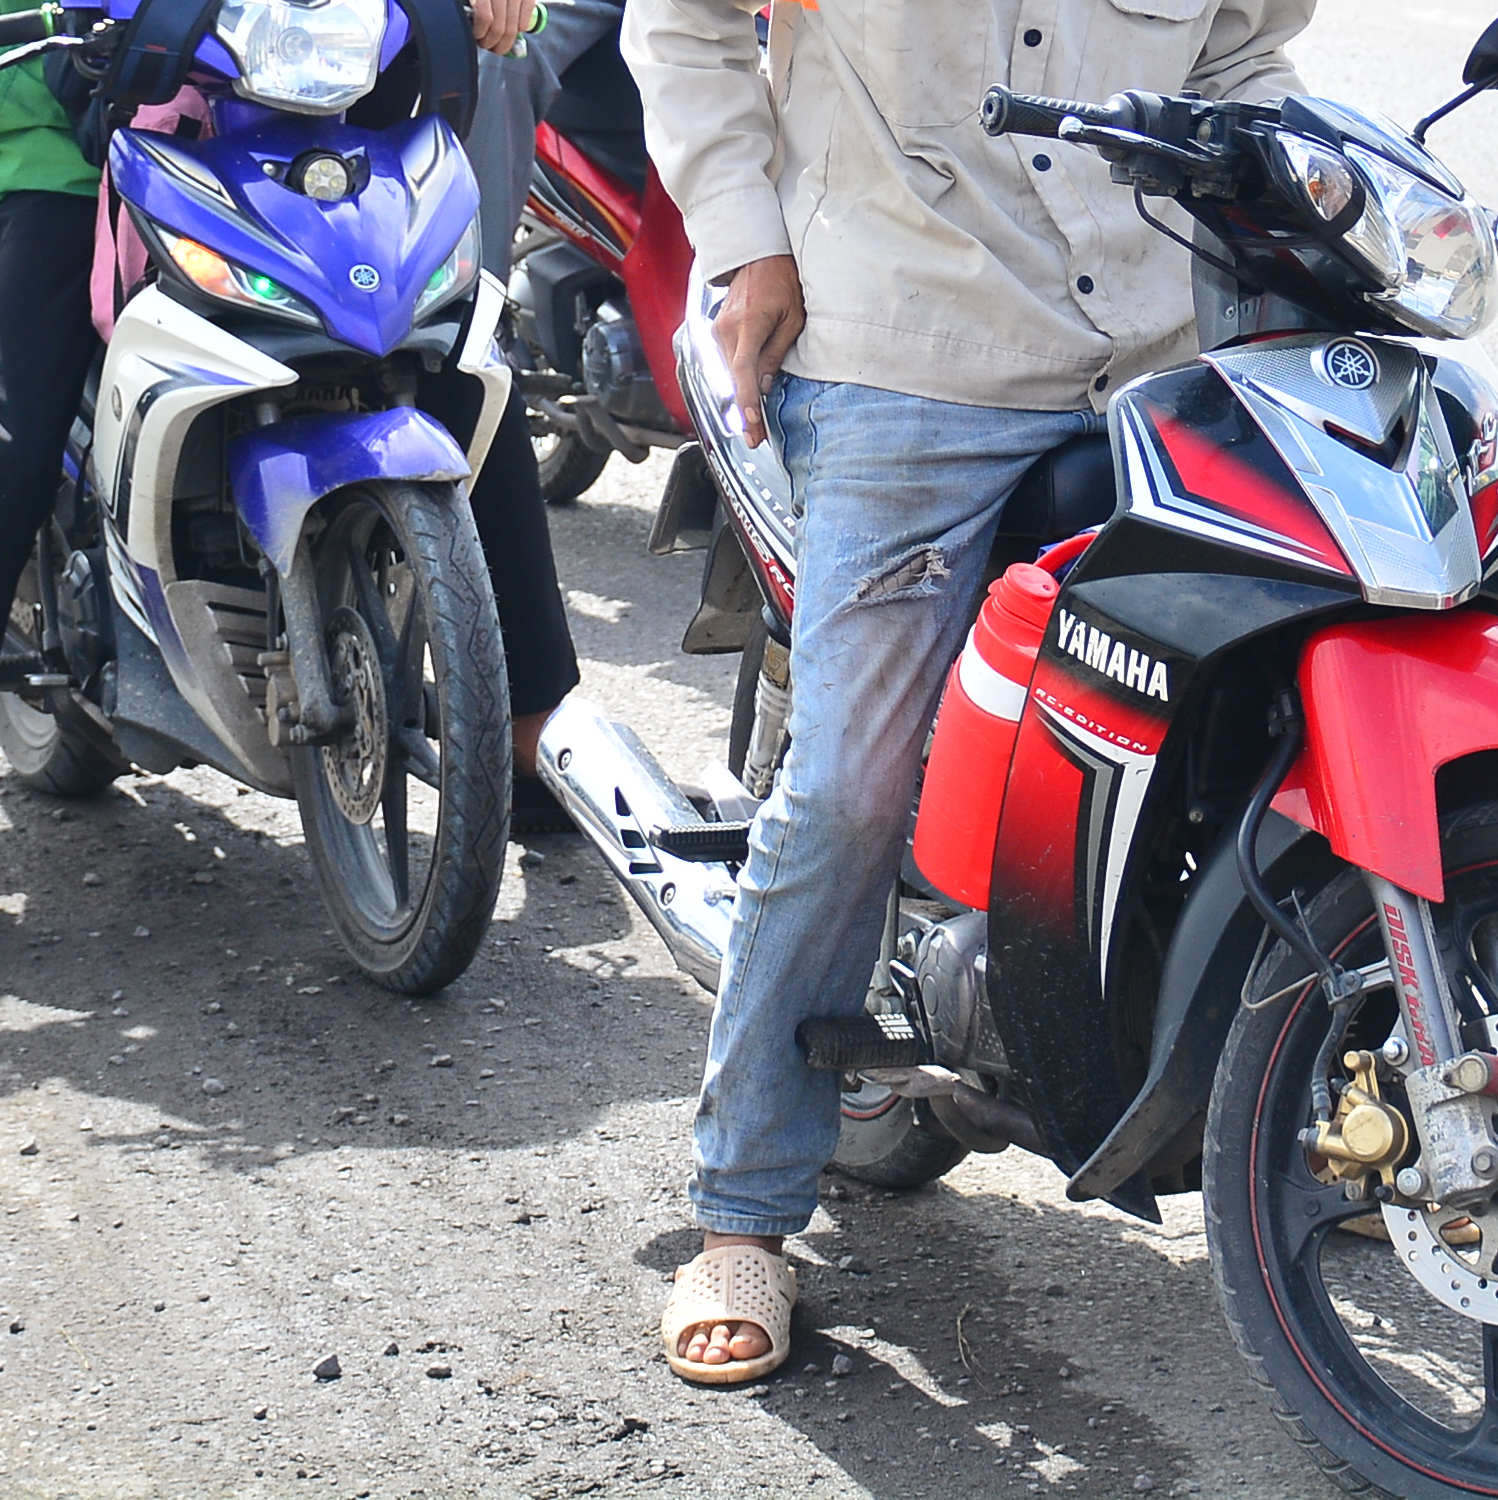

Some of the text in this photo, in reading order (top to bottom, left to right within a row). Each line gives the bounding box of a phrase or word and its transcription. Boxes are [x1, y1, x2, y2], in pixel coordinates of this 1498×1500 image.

[742, 461, 796, 529] 4-STR
[1057, 608, 1169, 702] YAMAHA
[1035, 687, 1148, 752] RC-EDITION
[1383, 902, 1419, 990] DISK
